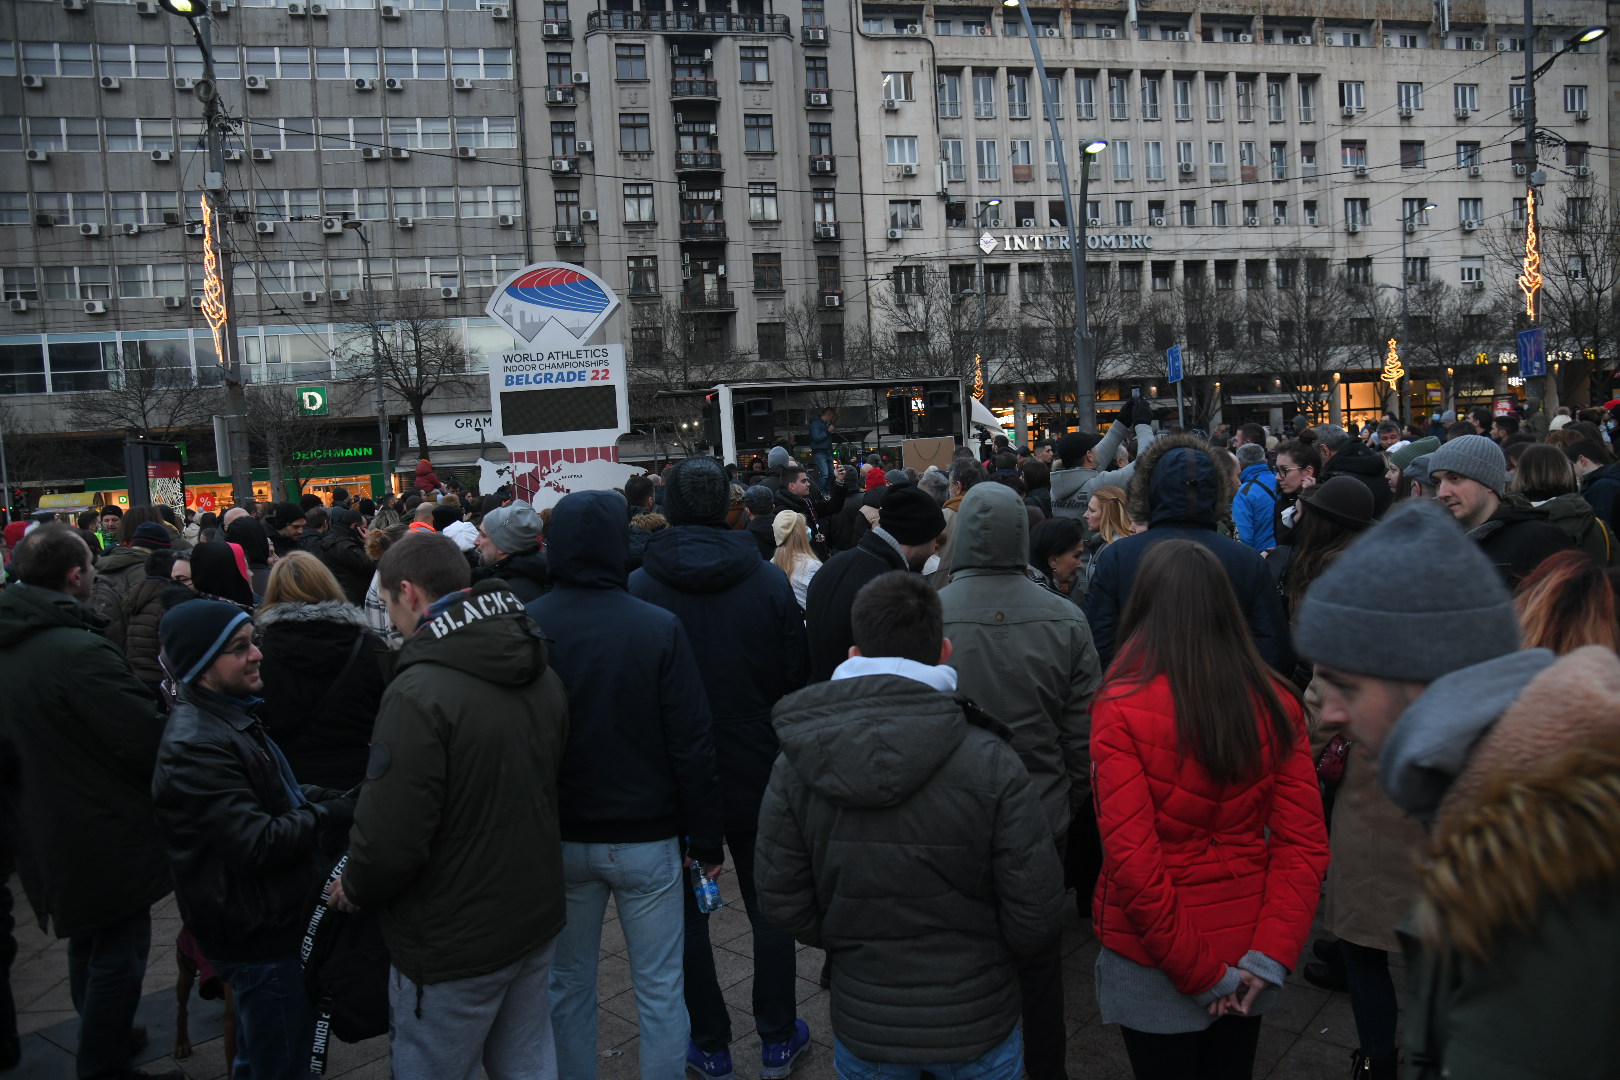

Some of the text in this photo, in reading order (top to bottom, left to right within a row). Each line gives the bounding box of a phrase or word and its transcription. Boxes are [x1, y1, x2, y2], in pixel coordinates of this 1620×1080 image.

[1003, 234, 1152, 251] INTEROMERC
[503, 348, 609, 363] WORLD ATHLETICS
[503, 360, 610, 373] INDOOR CHAMPIONSHIPS
[504, 369, 610, 386] BELGRADE 22
[302, 391, 323, 411] D
[454, 417, 492, 429] GRAM
[291, 447, 373, 460] DEICHMANN
[312, 1020, 329, 1054] GOING
